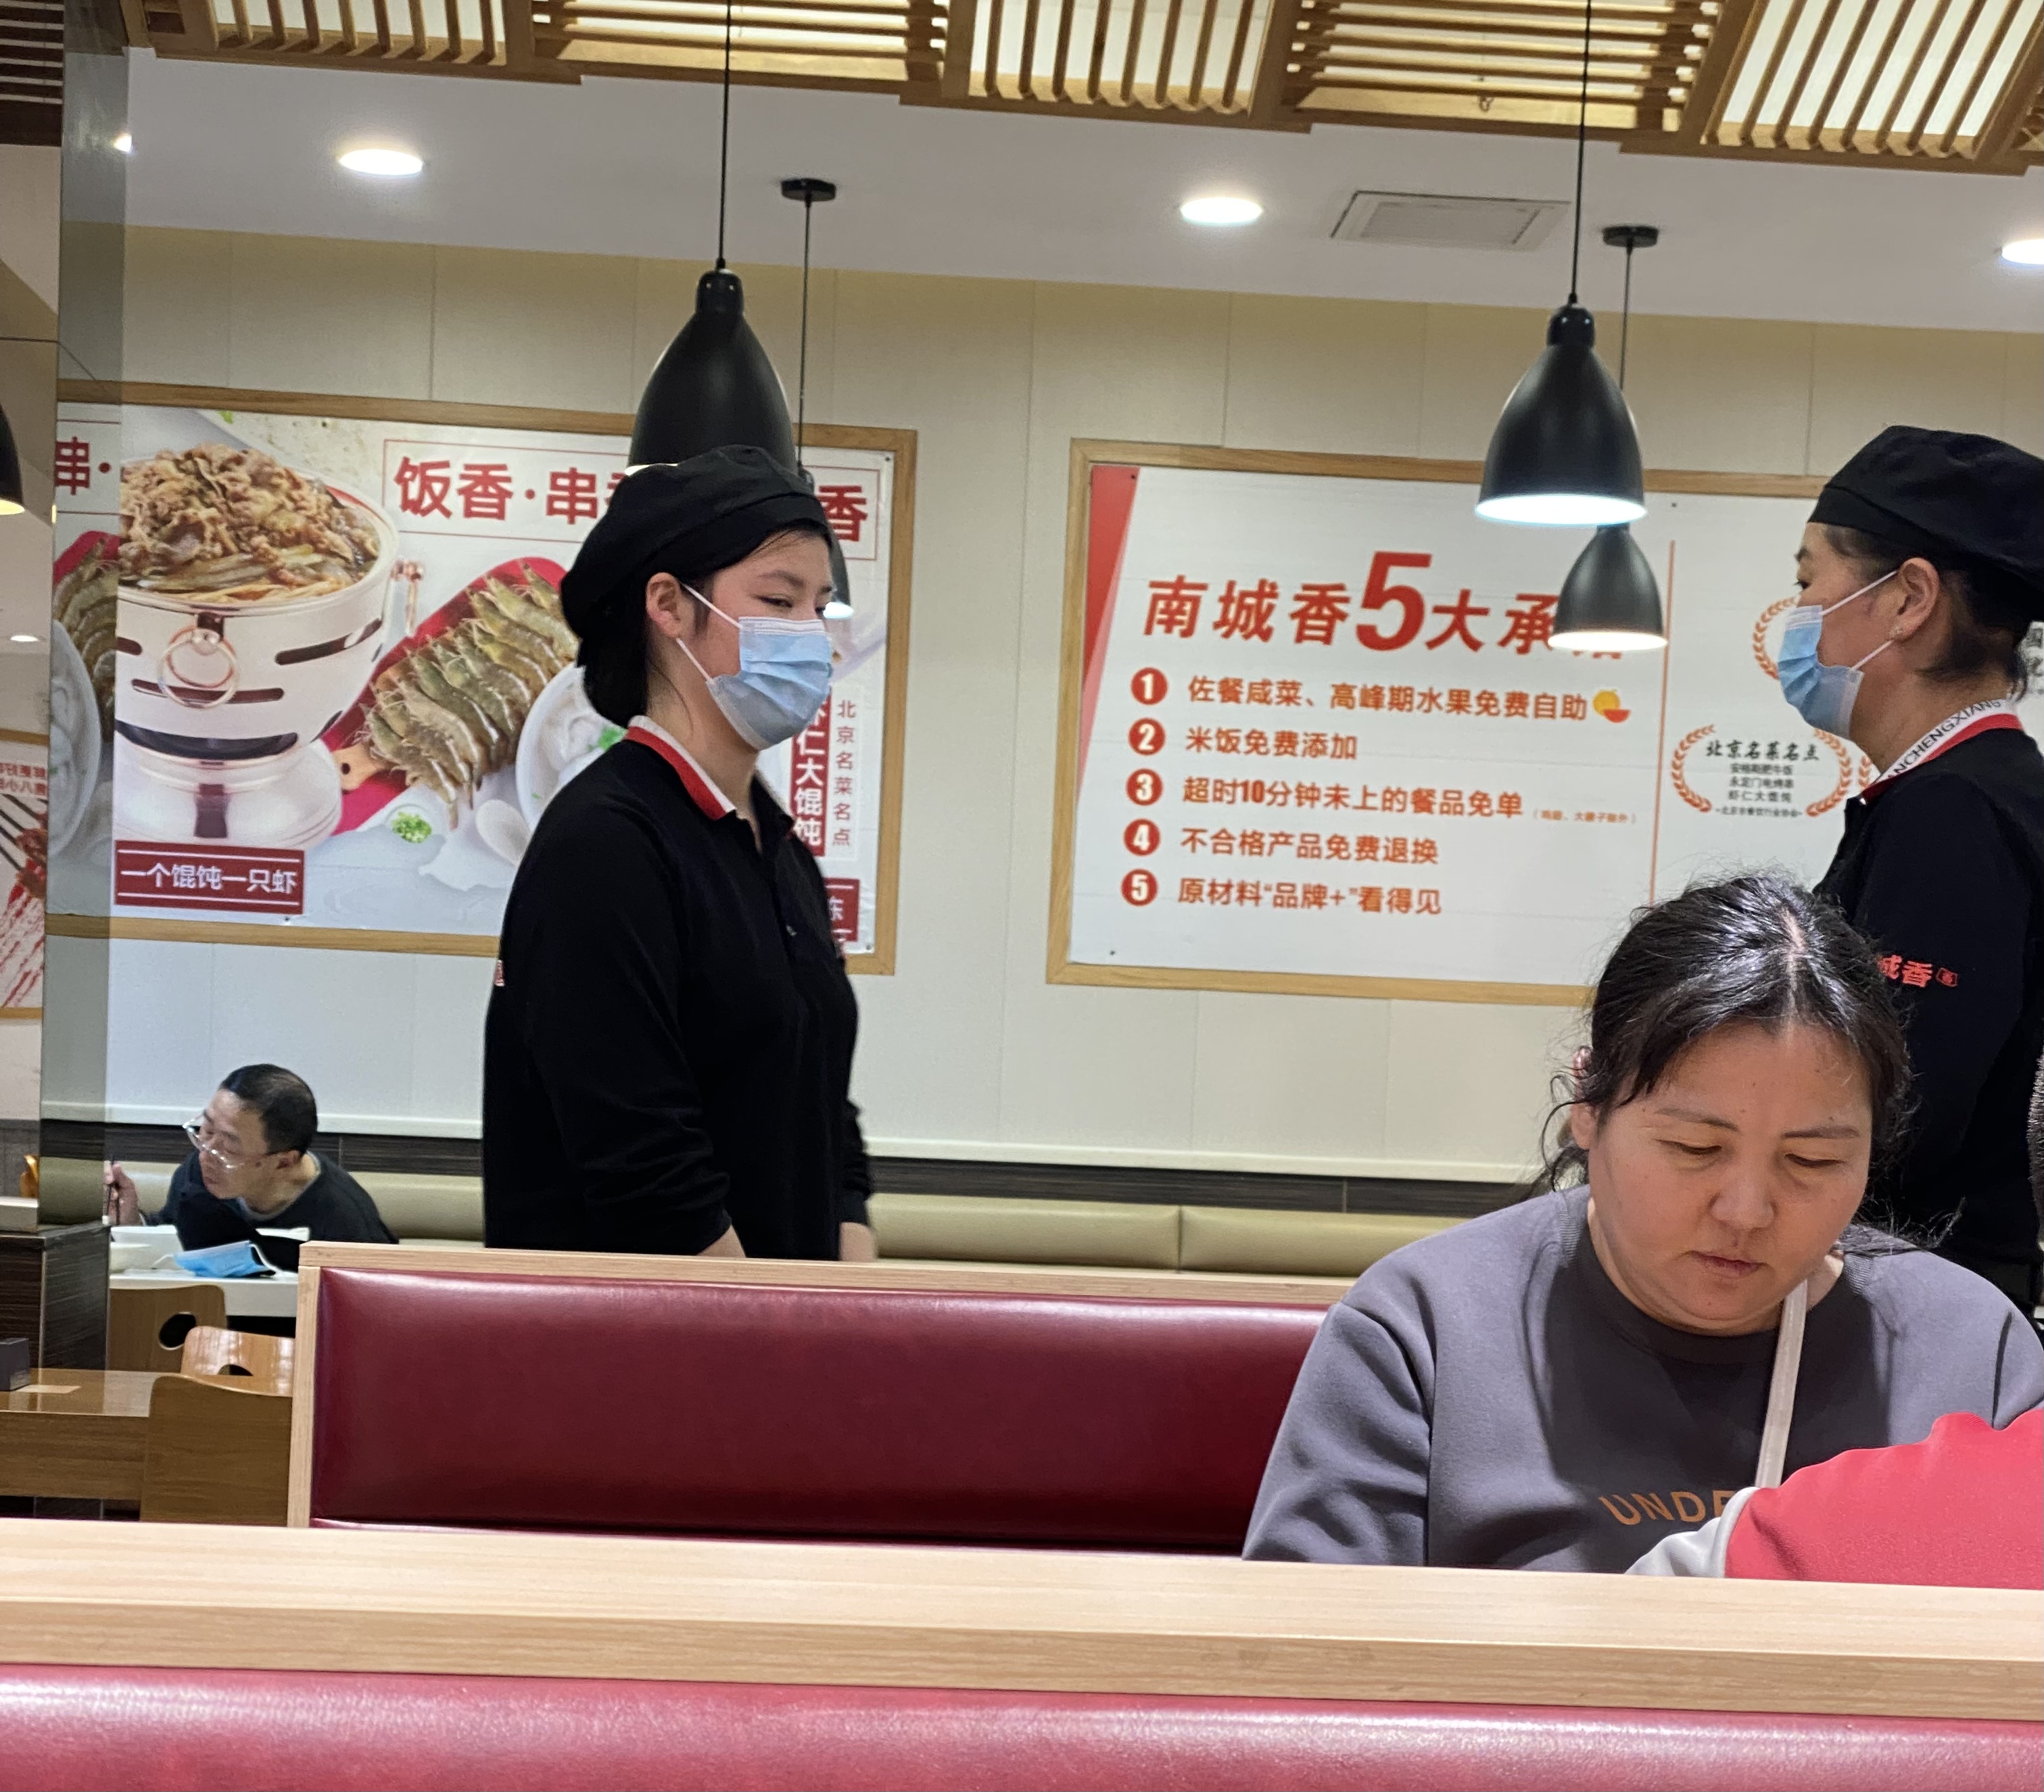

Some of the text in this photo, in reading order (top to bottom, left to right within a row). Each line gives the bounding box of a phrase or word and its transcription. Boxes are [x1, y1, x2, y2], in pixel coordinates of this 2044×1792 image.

[1143, 550, 1621, 660] 南城香5大承
[1187, 674, 1588, 721] 佐餐咸菜、高峰期水果免费自助
[1185, 725, 1358, 760] 米饭免费添加
[793, 700, 827, 846] 仁大馄饨
[832, 699, 856, 846] 北京名菜名点
[1183, 775, 1523, 819] 超时10分钟未上的餐品免单
[1181, 827, 1438, 865] 不合格产品免费退换
[120, 862, 297, 894] 一个馄饨一只虾
